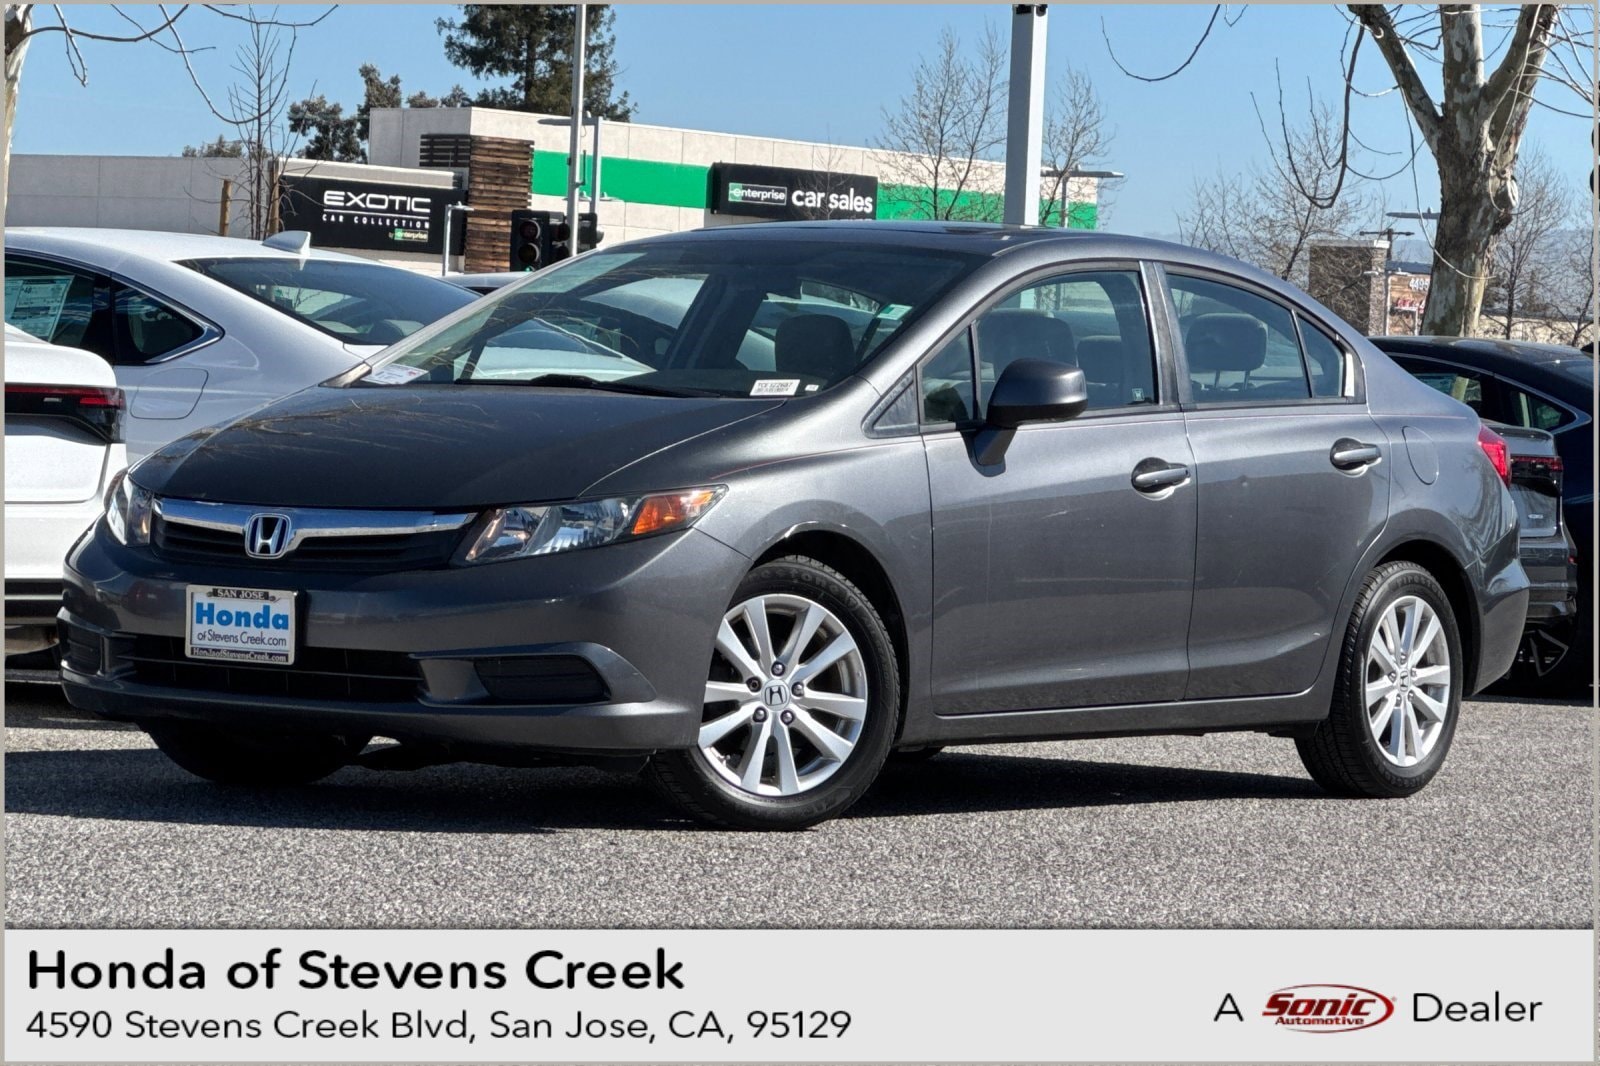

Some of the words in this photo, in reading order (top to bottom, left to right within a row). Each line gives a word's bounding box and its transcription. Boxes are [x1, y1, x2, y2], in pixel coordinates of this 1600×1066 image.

[323, 190, 431, 213] EXOTIC
[731, 186, 785, 201] enterprise
[791, 189, 826, 207] car
[828, 187, 873, 213] sales
[322, 213, 344, 222] CAR
[353, 216, 430, 229] COLLECTION
[396, 231, 428, 239] enterprise
[217, 588, 237, 598] SAN
[239, 590, 265, 600] JOSE
[195, 602, 289, 630] Honda
[197, 630, 207, 641] of
[207, 629, 239, 643] Stevens
[240, 631, 287, 647] Creek.com
